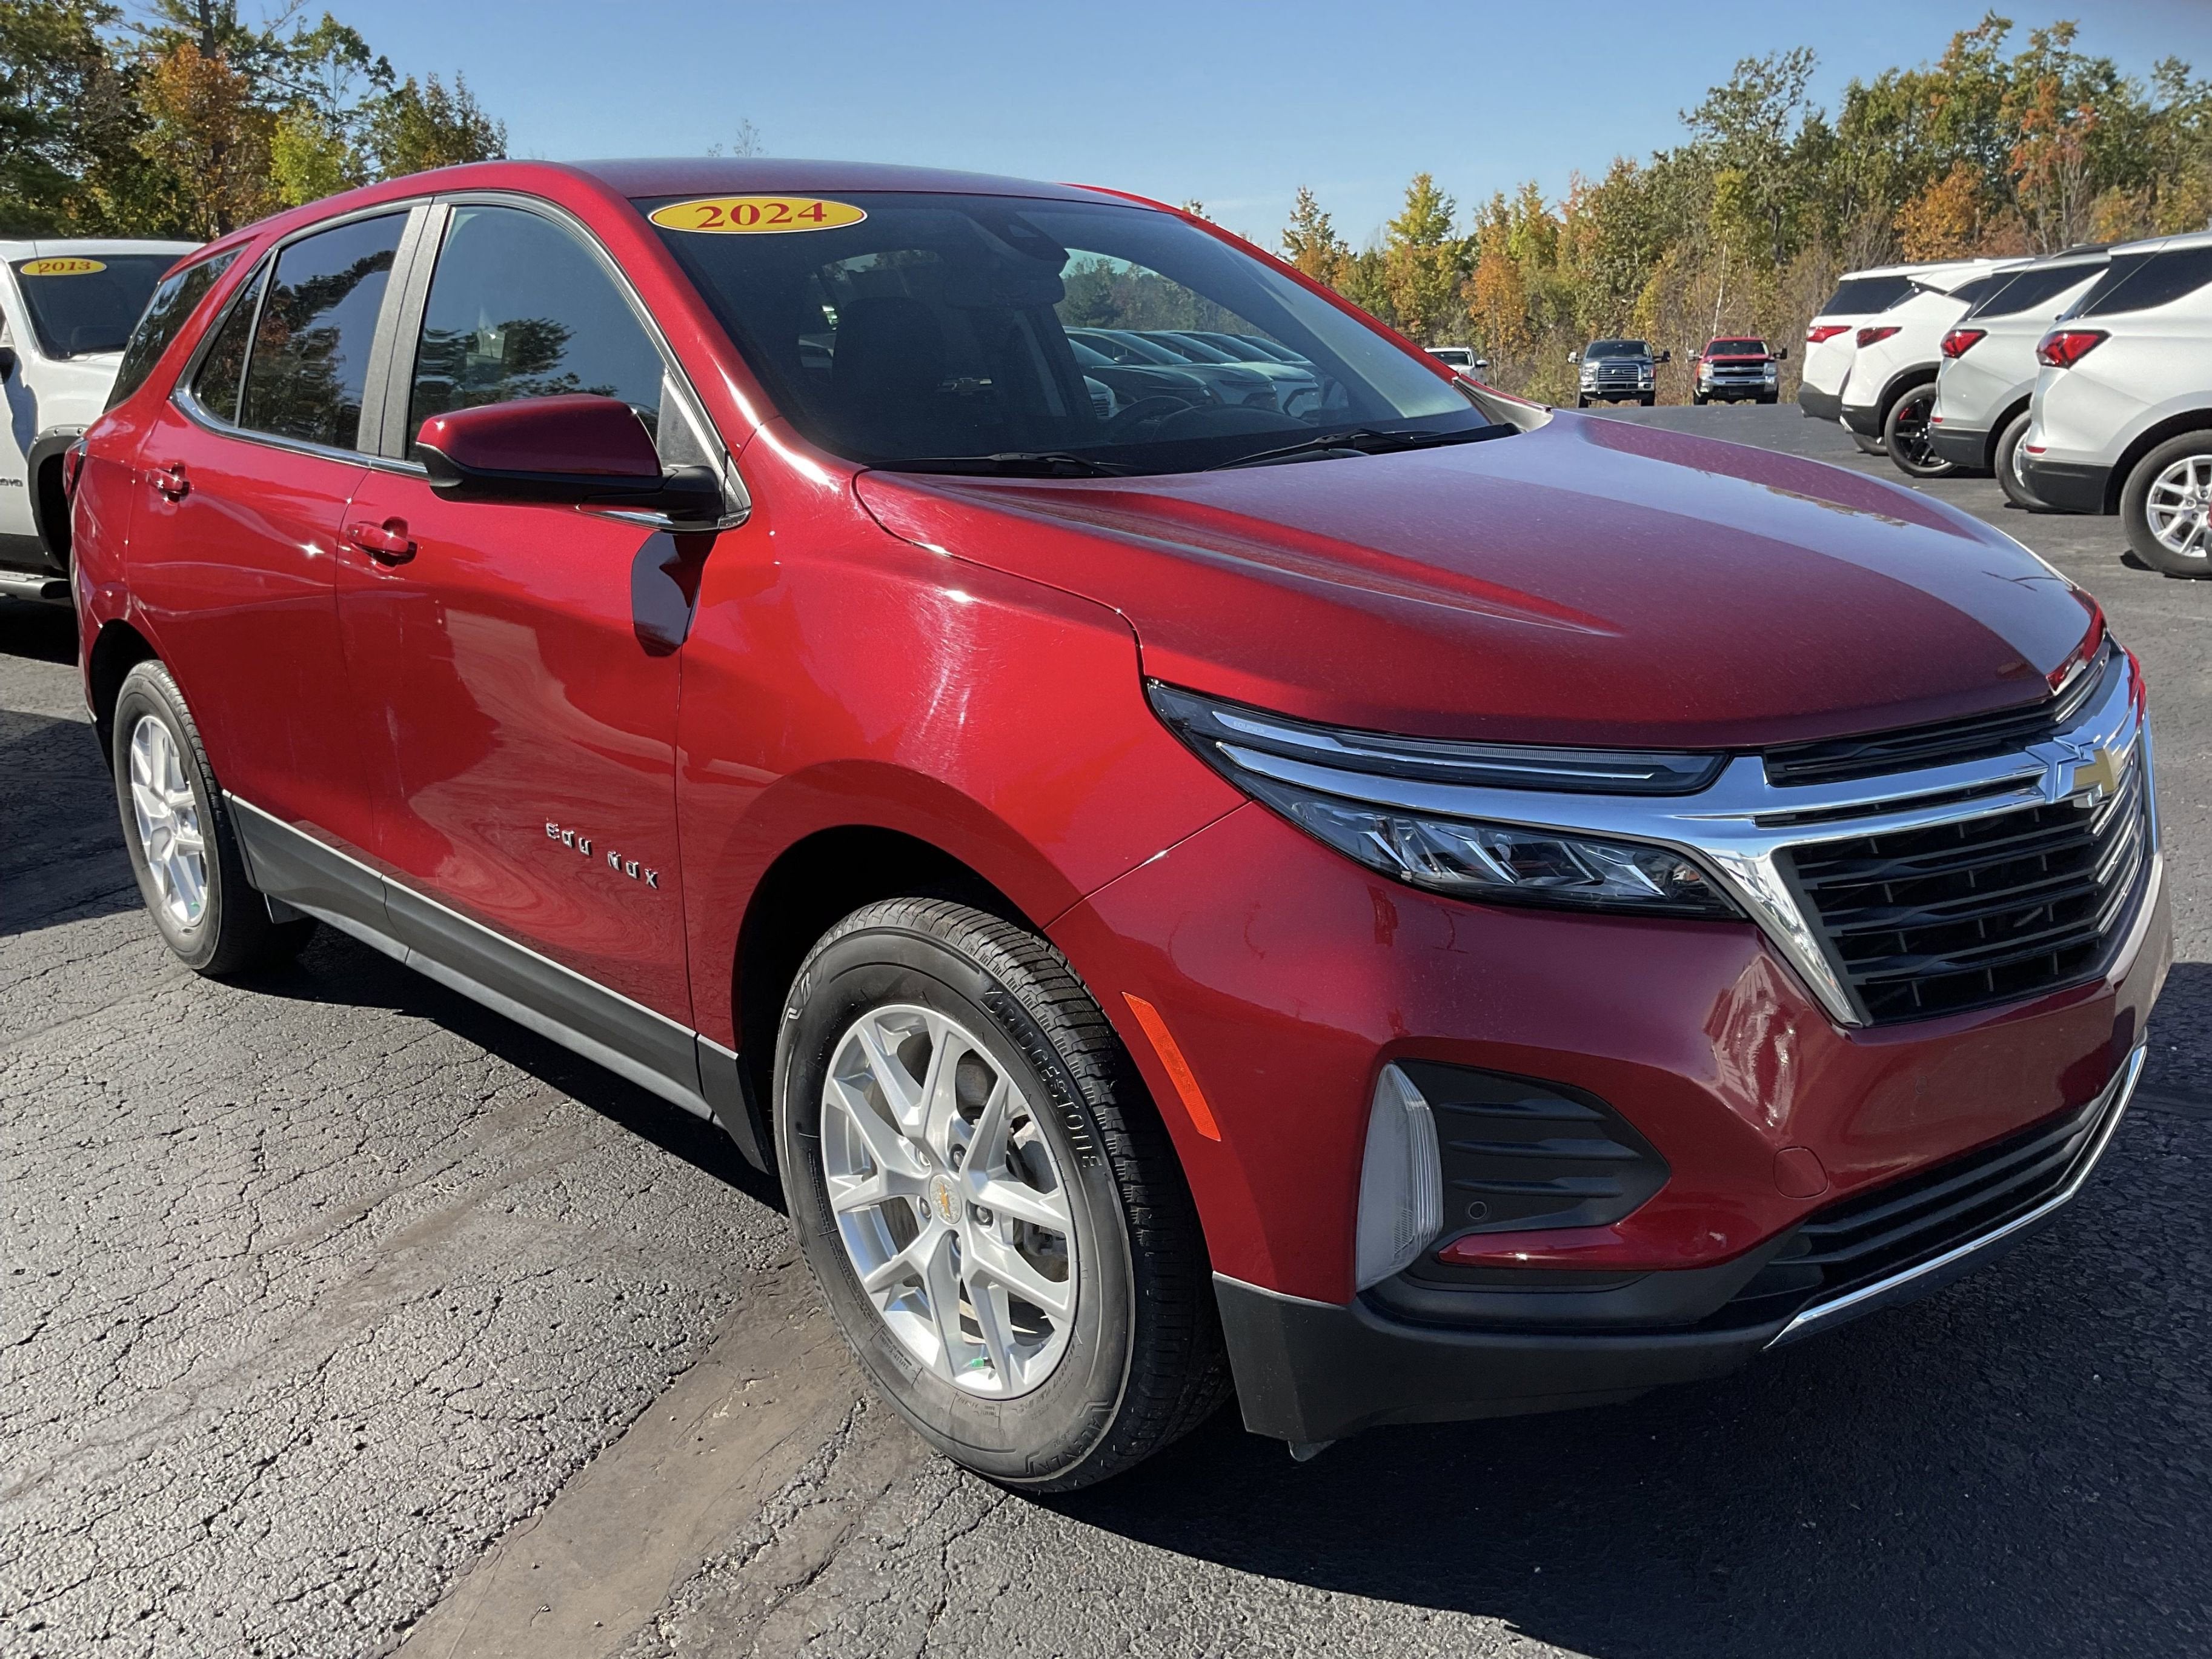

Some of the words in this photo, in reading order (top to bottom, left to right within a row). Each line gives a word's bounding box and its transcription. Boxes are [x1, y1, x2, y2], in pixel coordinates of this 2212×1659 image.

[696, 202, 827, 228] 2024
[39, 261, 91, 274] 2013
[546, 822, 659, 889] EQUNOX
[979, 988, 1102, 1168] BRIDGESTONE
